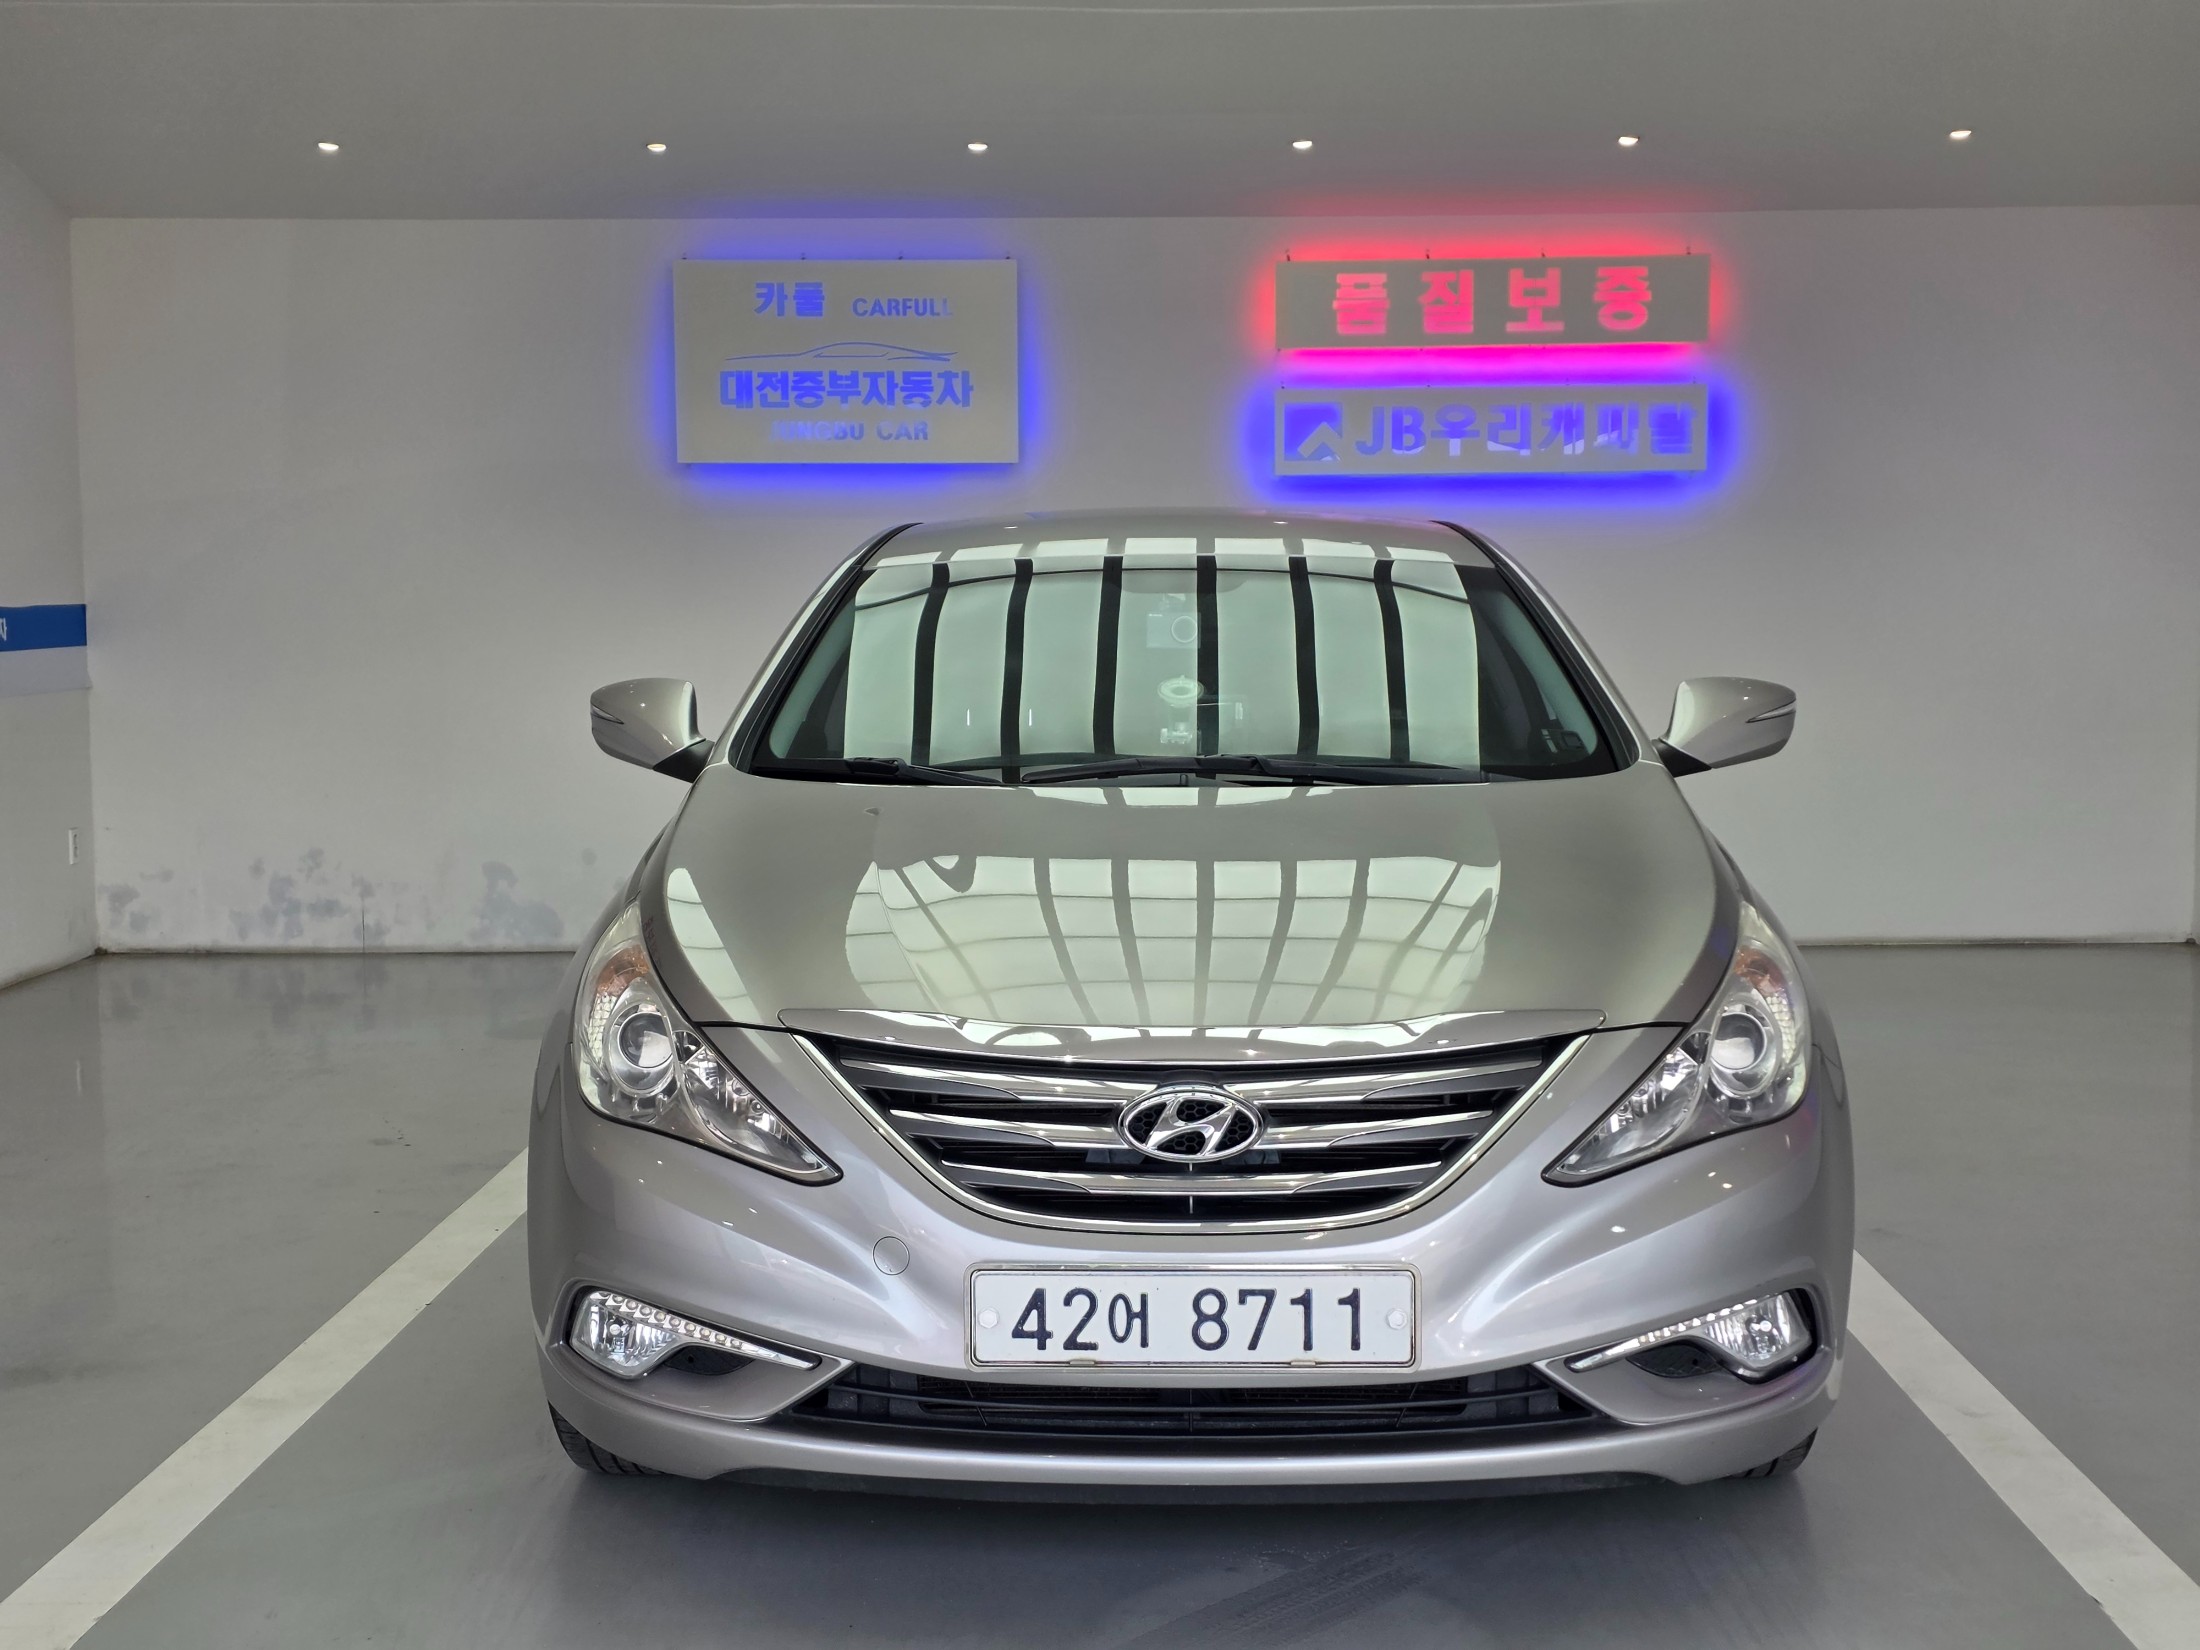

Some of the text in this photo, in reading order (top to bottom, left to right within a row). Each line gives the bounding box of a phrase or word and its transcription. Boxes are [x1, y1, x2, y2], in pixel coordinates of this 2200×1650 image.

[852, 297, 954, 318] CARFULL
[1332, 266, 1652, 336] 품질보증
[719, 369, 974, 409] 대전중부자동차
[876, 421, 929, 441] CAR
[1353, 401, 1696, 457] JB우리캐피탈
[1011, 1287, 1362, 1351] 42어 8711
